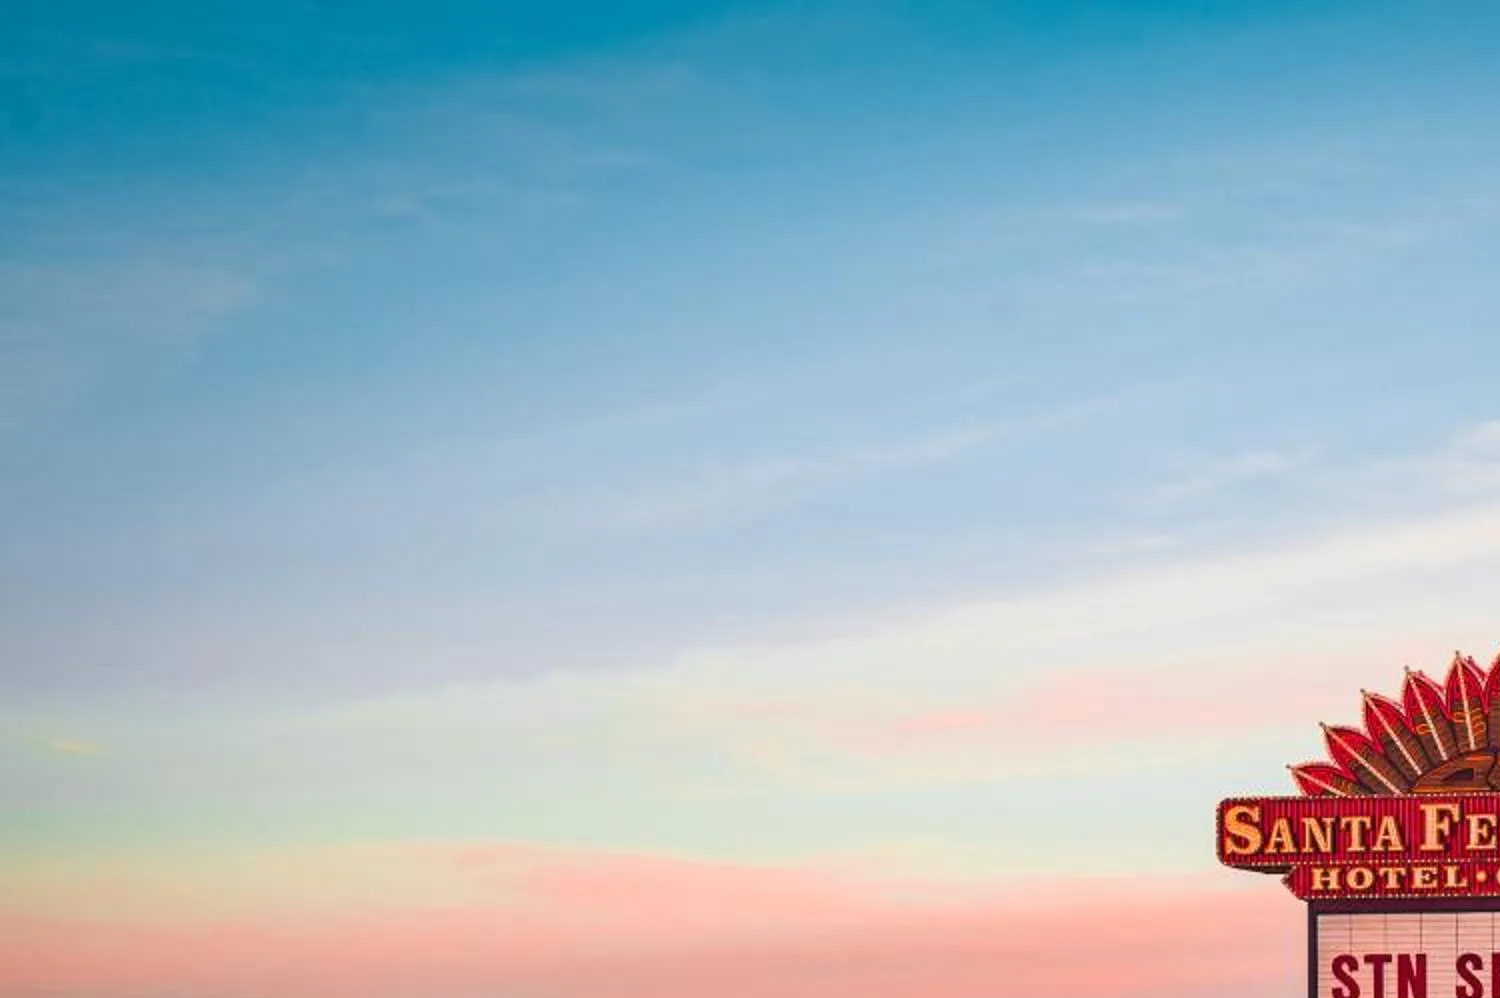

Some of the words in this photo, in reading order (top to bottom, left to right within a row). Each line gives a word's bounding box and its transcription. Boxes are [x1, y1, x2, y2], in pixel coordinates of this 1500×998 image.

[1224, 804, 1405, 855] SANTA
[1419, 803, 1497, 851] FE
[1311, 867, 1469, 890] HOTEL
